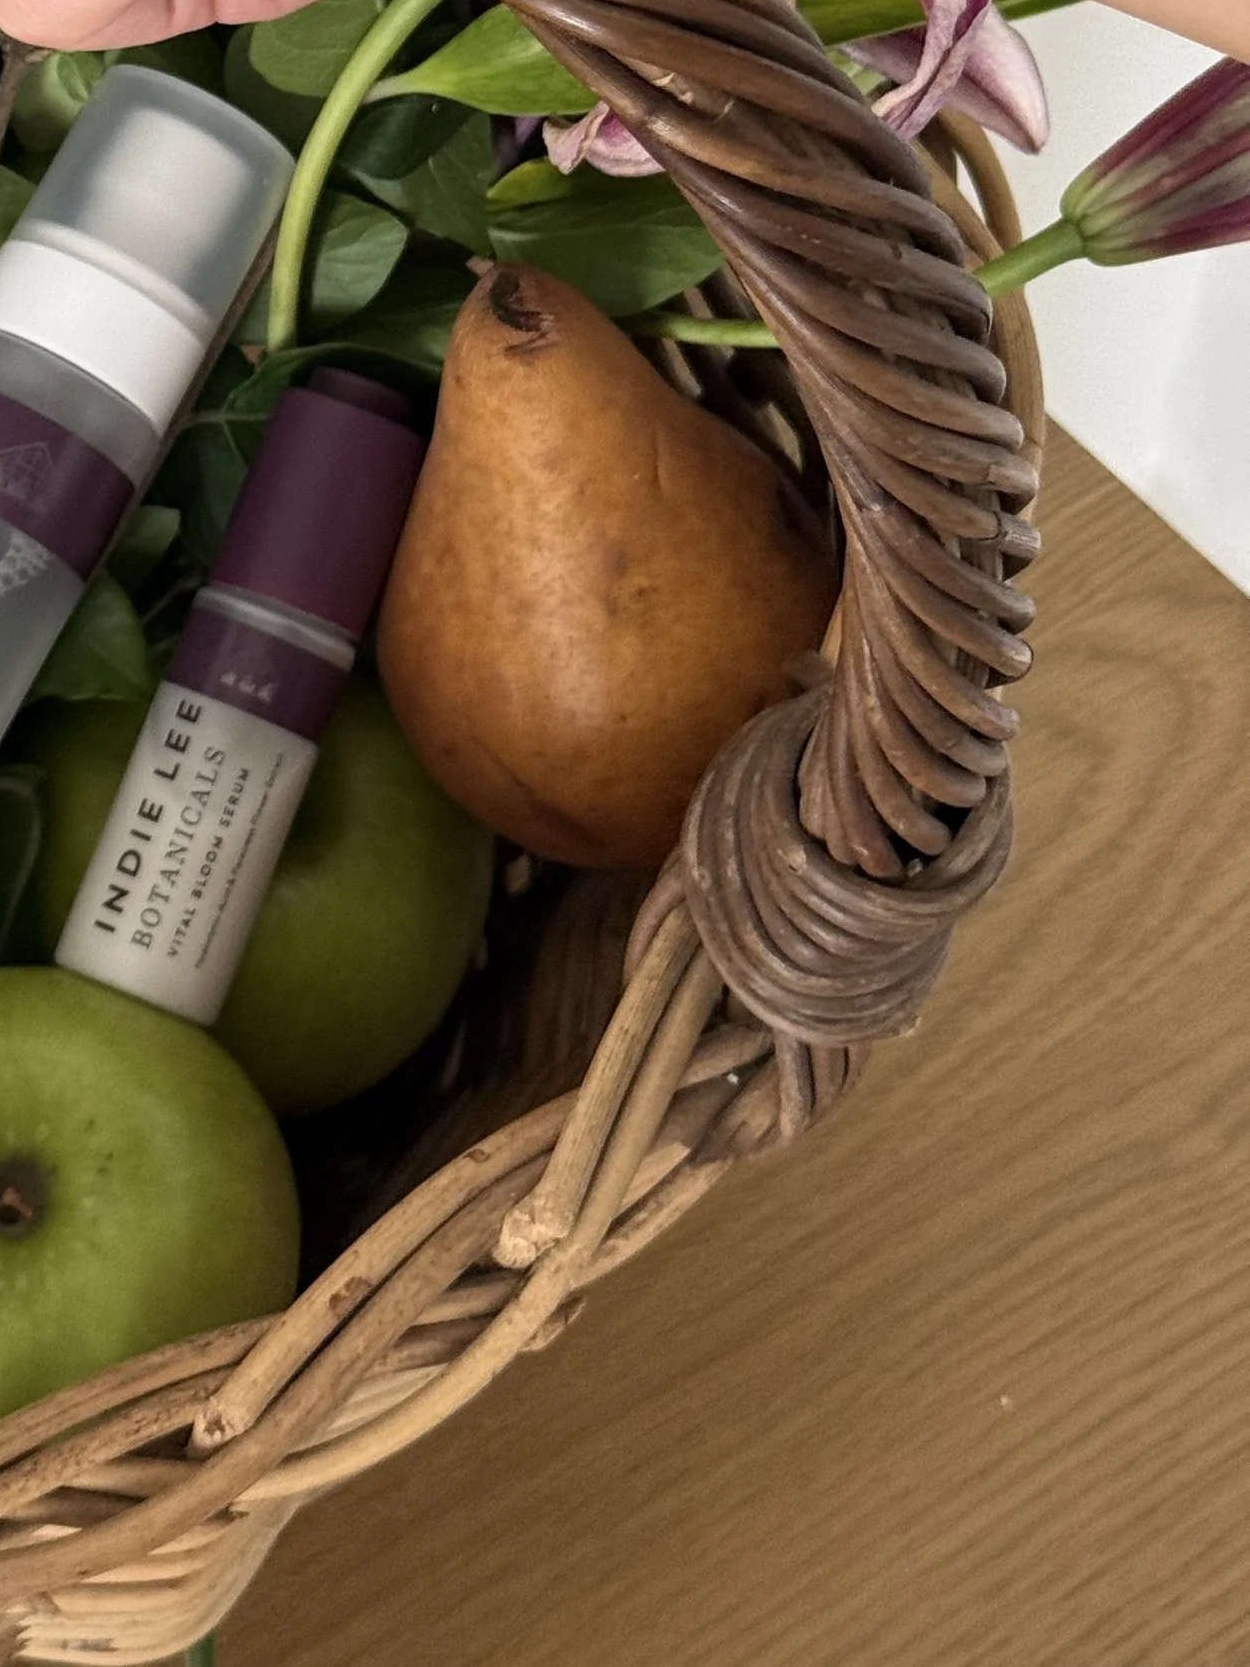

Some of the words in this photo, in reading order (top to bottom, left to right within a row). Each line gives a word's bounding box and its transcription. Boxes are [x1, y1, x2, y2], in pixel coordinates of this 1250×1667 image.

[94, 799, 165, 933] INDIE
[154, 700, 203, 781] LEE
[131, 747, 227, 948] BOTANICALS
[167, 907, 195, 957] VITAL
[190, 837, 224, 897] BLOOM
[219, 769, 251, 826] SERUM
